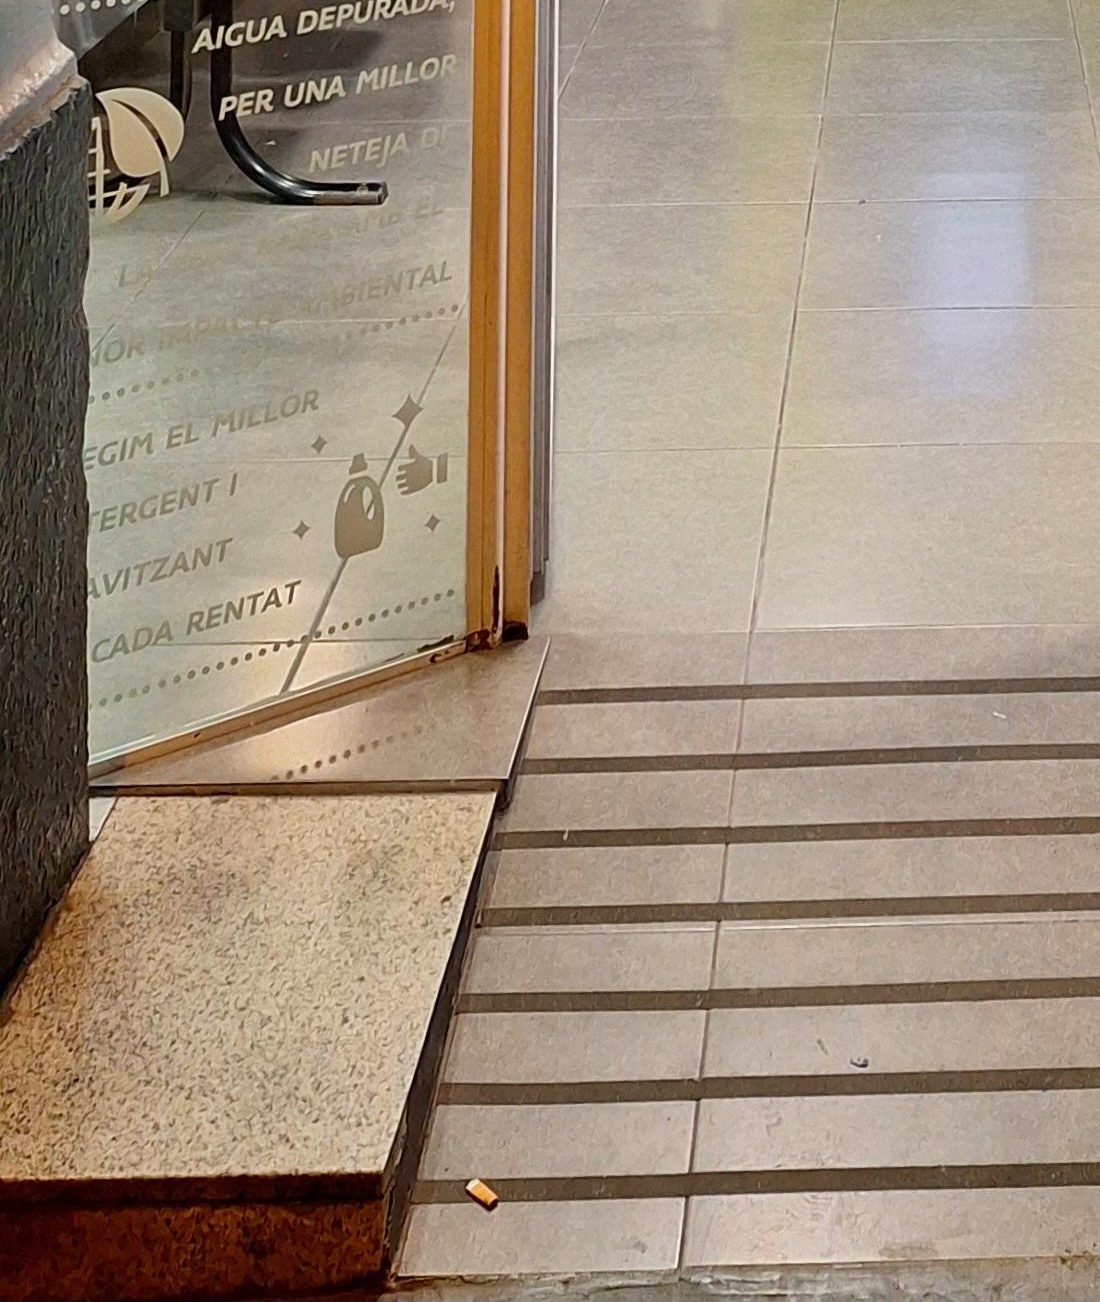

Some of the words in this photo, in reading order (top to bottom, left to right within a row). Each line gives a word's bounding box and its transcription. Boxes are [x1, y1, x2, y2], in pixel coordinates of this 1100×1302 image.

[191, 12, 288, 55] AIGUA
[217, 88, 275, 122] PER
[283, 73, 347, 108] UNA
[354, 53, 459, 96] MILLOR
[308, 132, 411, 174] NETEJA
[166, 423, 200, 450] EL
[211, 389, 320, 439] MILLOR
[227, 471, 238, 497] I
[91, 623, 175, 665] CADA
[185, 579, 302, 637] RENTAT
